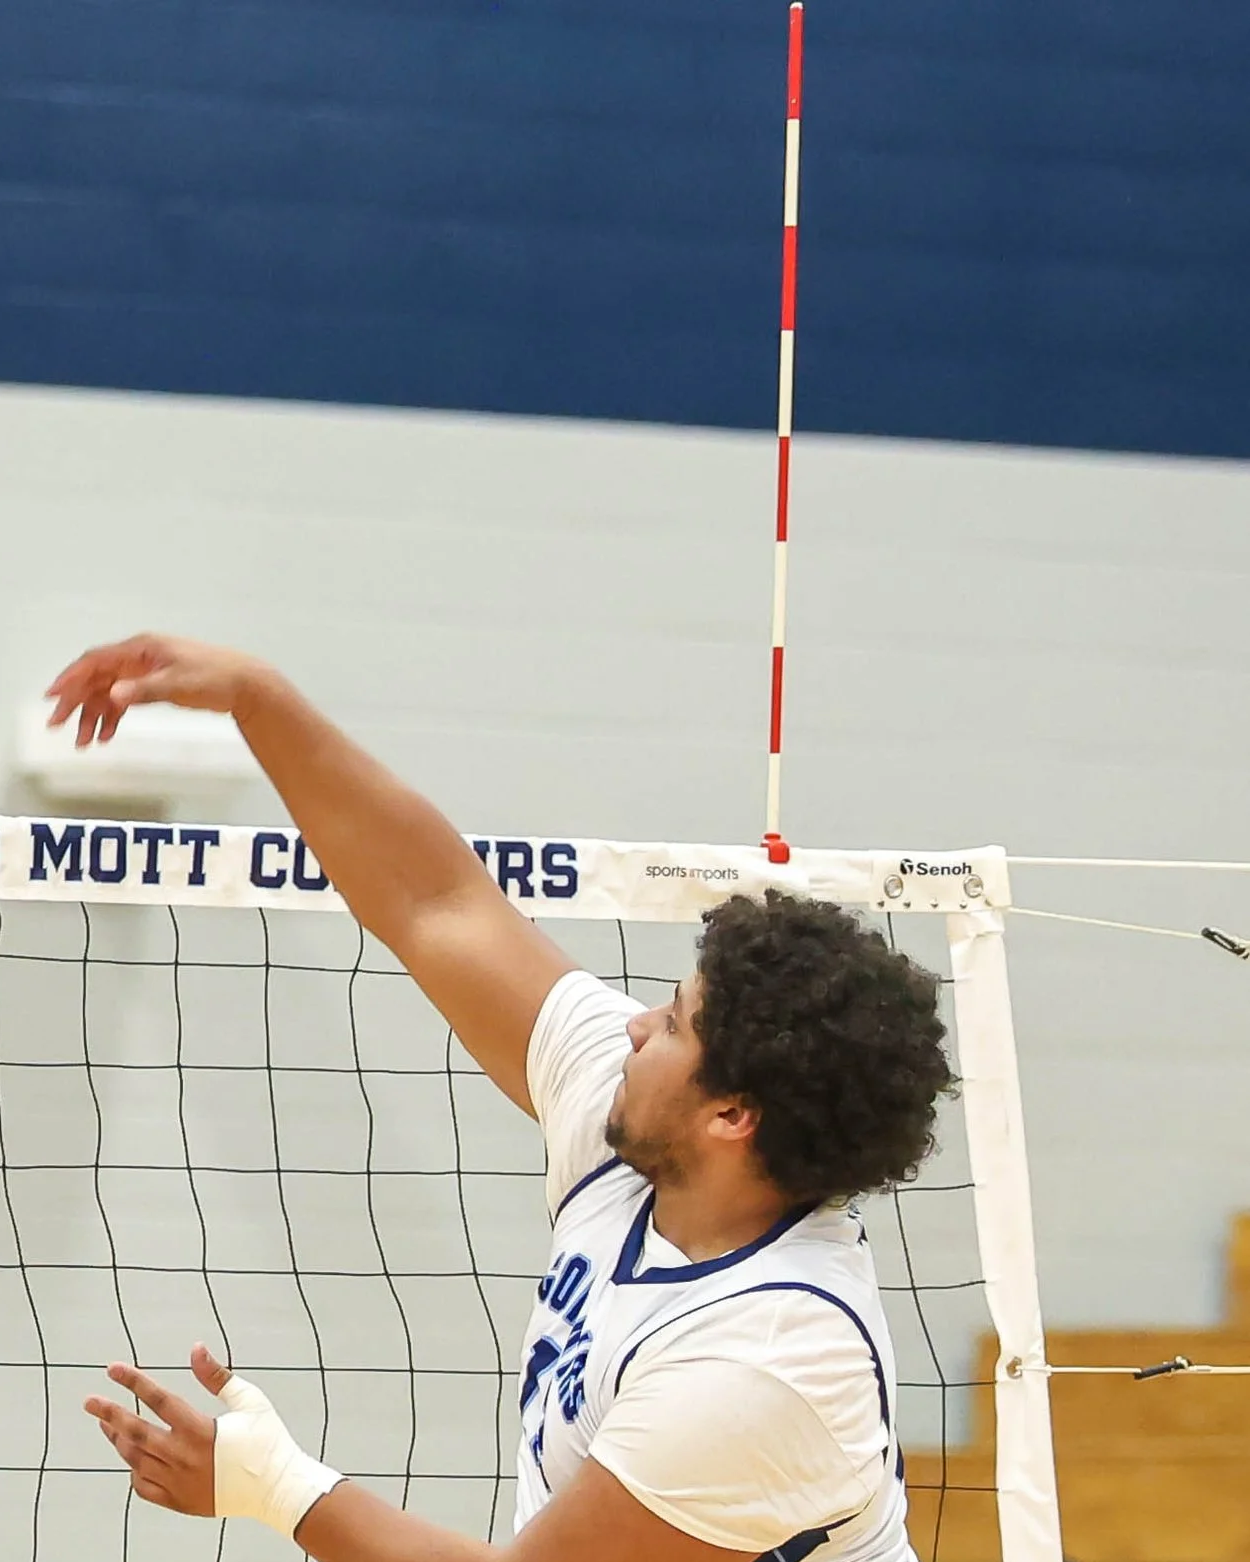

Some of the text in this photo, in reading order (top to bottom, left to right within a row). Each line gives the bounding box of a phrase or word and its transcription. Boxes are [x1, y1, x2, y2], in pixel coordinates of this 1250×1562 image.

[29, 823, 220, 886] MOTT
[250, 831, 578, 899] CORS
[916, 861, 972, 876] Senoh
[646, 865, 687, 879] sports
